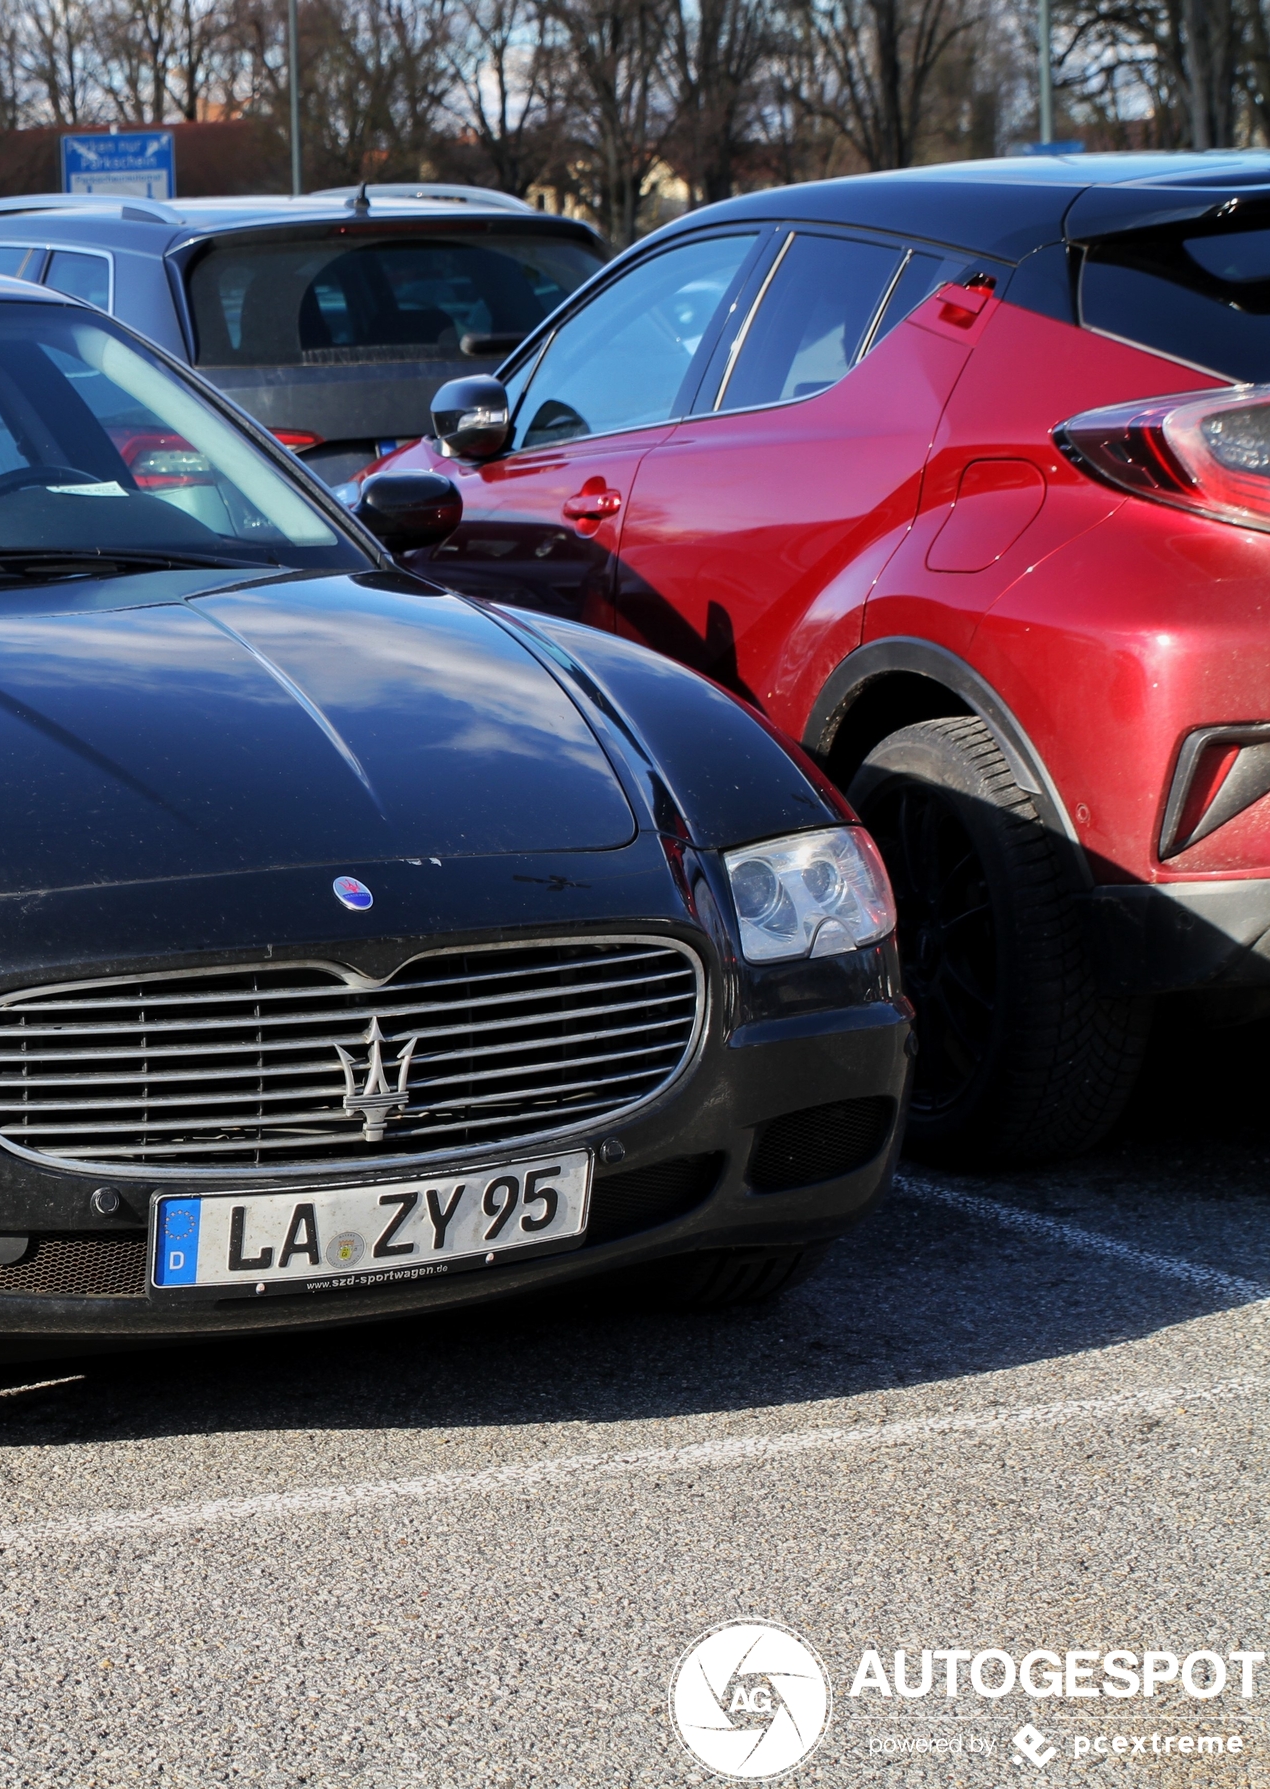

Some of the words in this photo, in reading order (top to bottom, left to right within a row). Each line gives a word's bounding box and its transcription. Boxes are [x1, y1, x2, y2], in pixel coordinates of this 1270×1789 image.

[228, 1203, 319, 1271] LA
[373, 1184, 465, 1258] ZY
[483, 1166, 561, 1241] 95
[169, 1251, 185, 1270] D
[306, 1265, 448, 1290] www.szd-sportwagen.de
